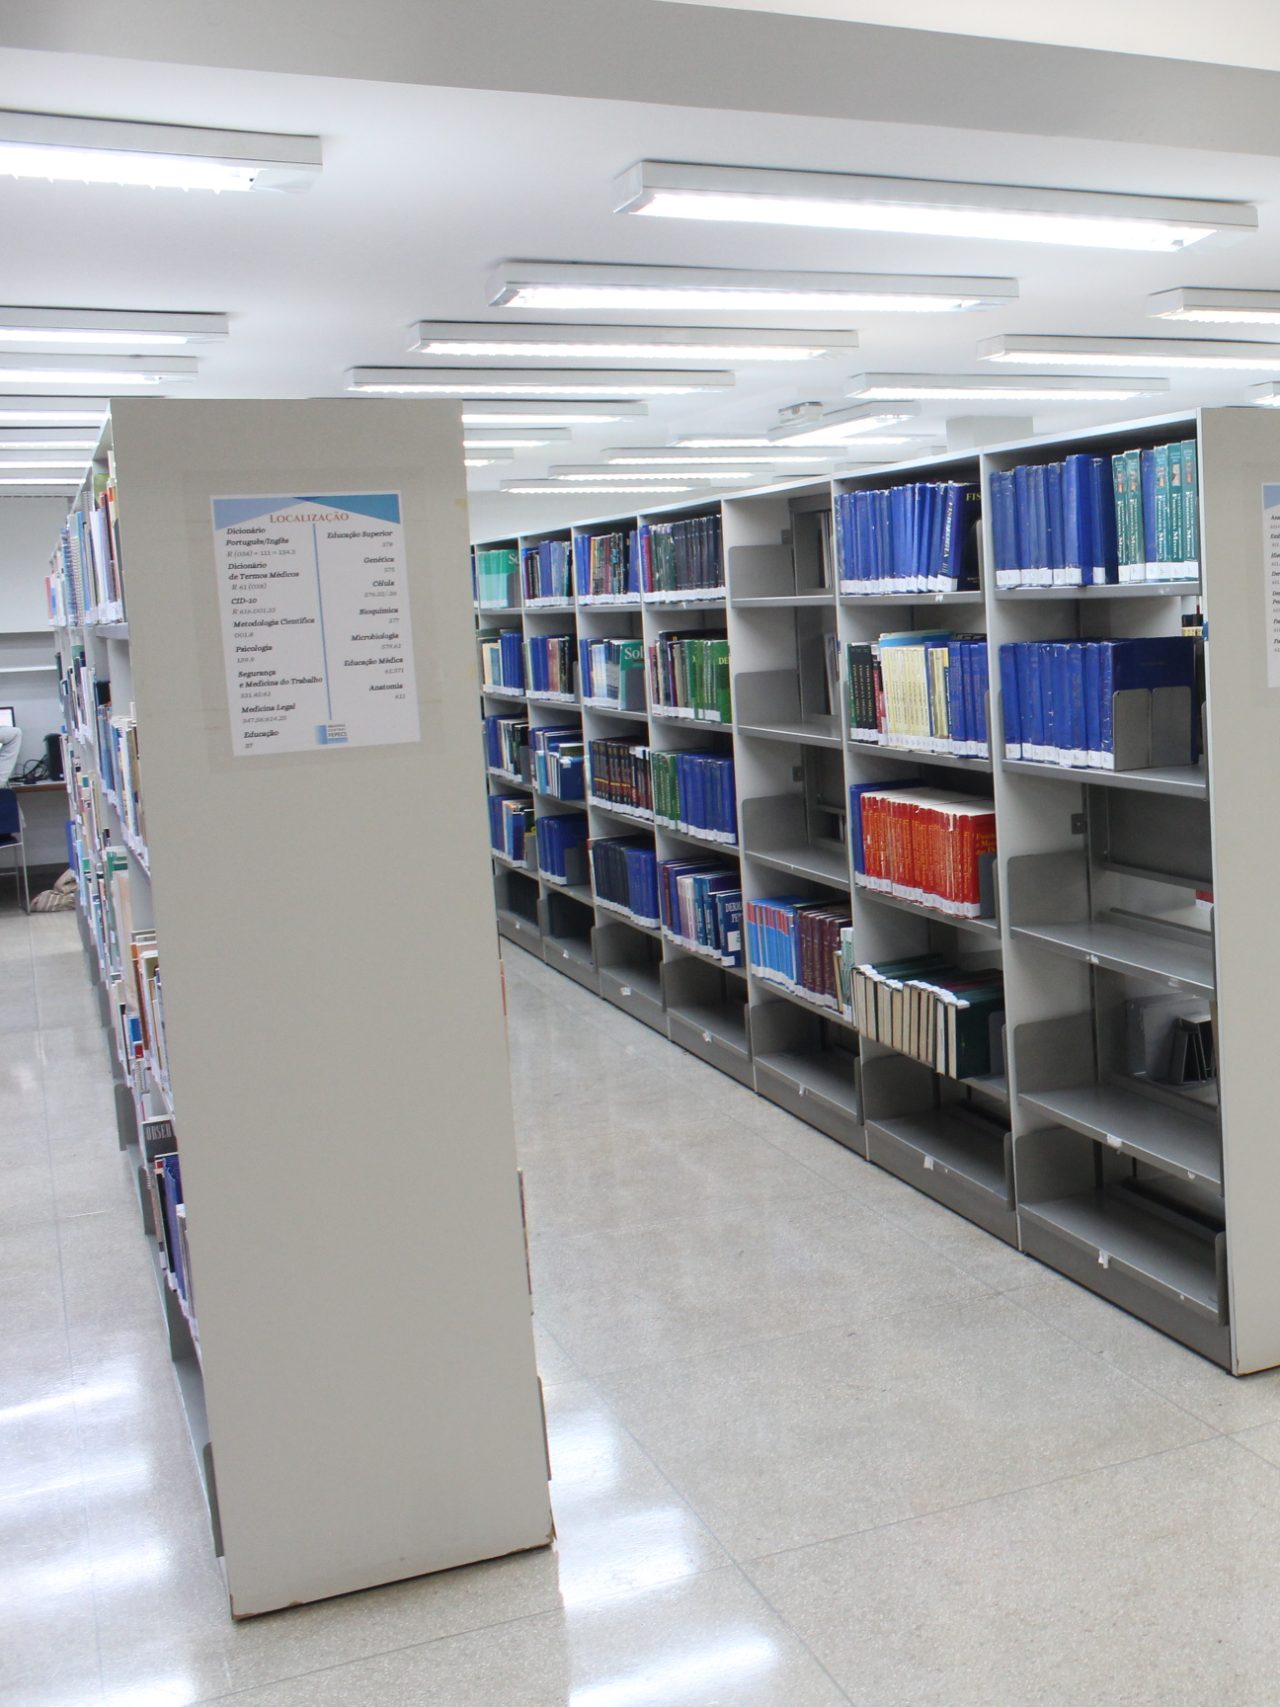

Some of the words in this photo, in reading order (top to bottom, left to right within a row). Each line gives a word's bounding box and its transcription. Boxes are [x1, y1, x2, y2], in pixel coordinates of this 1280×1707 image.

[270, 512, 349, 523] LOCALIZAÇÃO
[327, 531, 360, 539] Educação
[359, 608, 398, 616] Bioquímica
[234, 619, 279, 628] Metodologia
[280, 617, 316, 625] Científica
[352, 632, 400, 642] Microbiologia
[344, 658, 377, 666] Educação
[378, 656, 404, 664] Médica
[238, 670, 276, 678] Segurança
[245, 680, 278, 688] Medicina
[291, 676, 323, 684] Trabalho
[242, 705, 275, 714] Medicina
[276, 703, 296, 712] Legal
[244, 730, 280, 738] Educação
